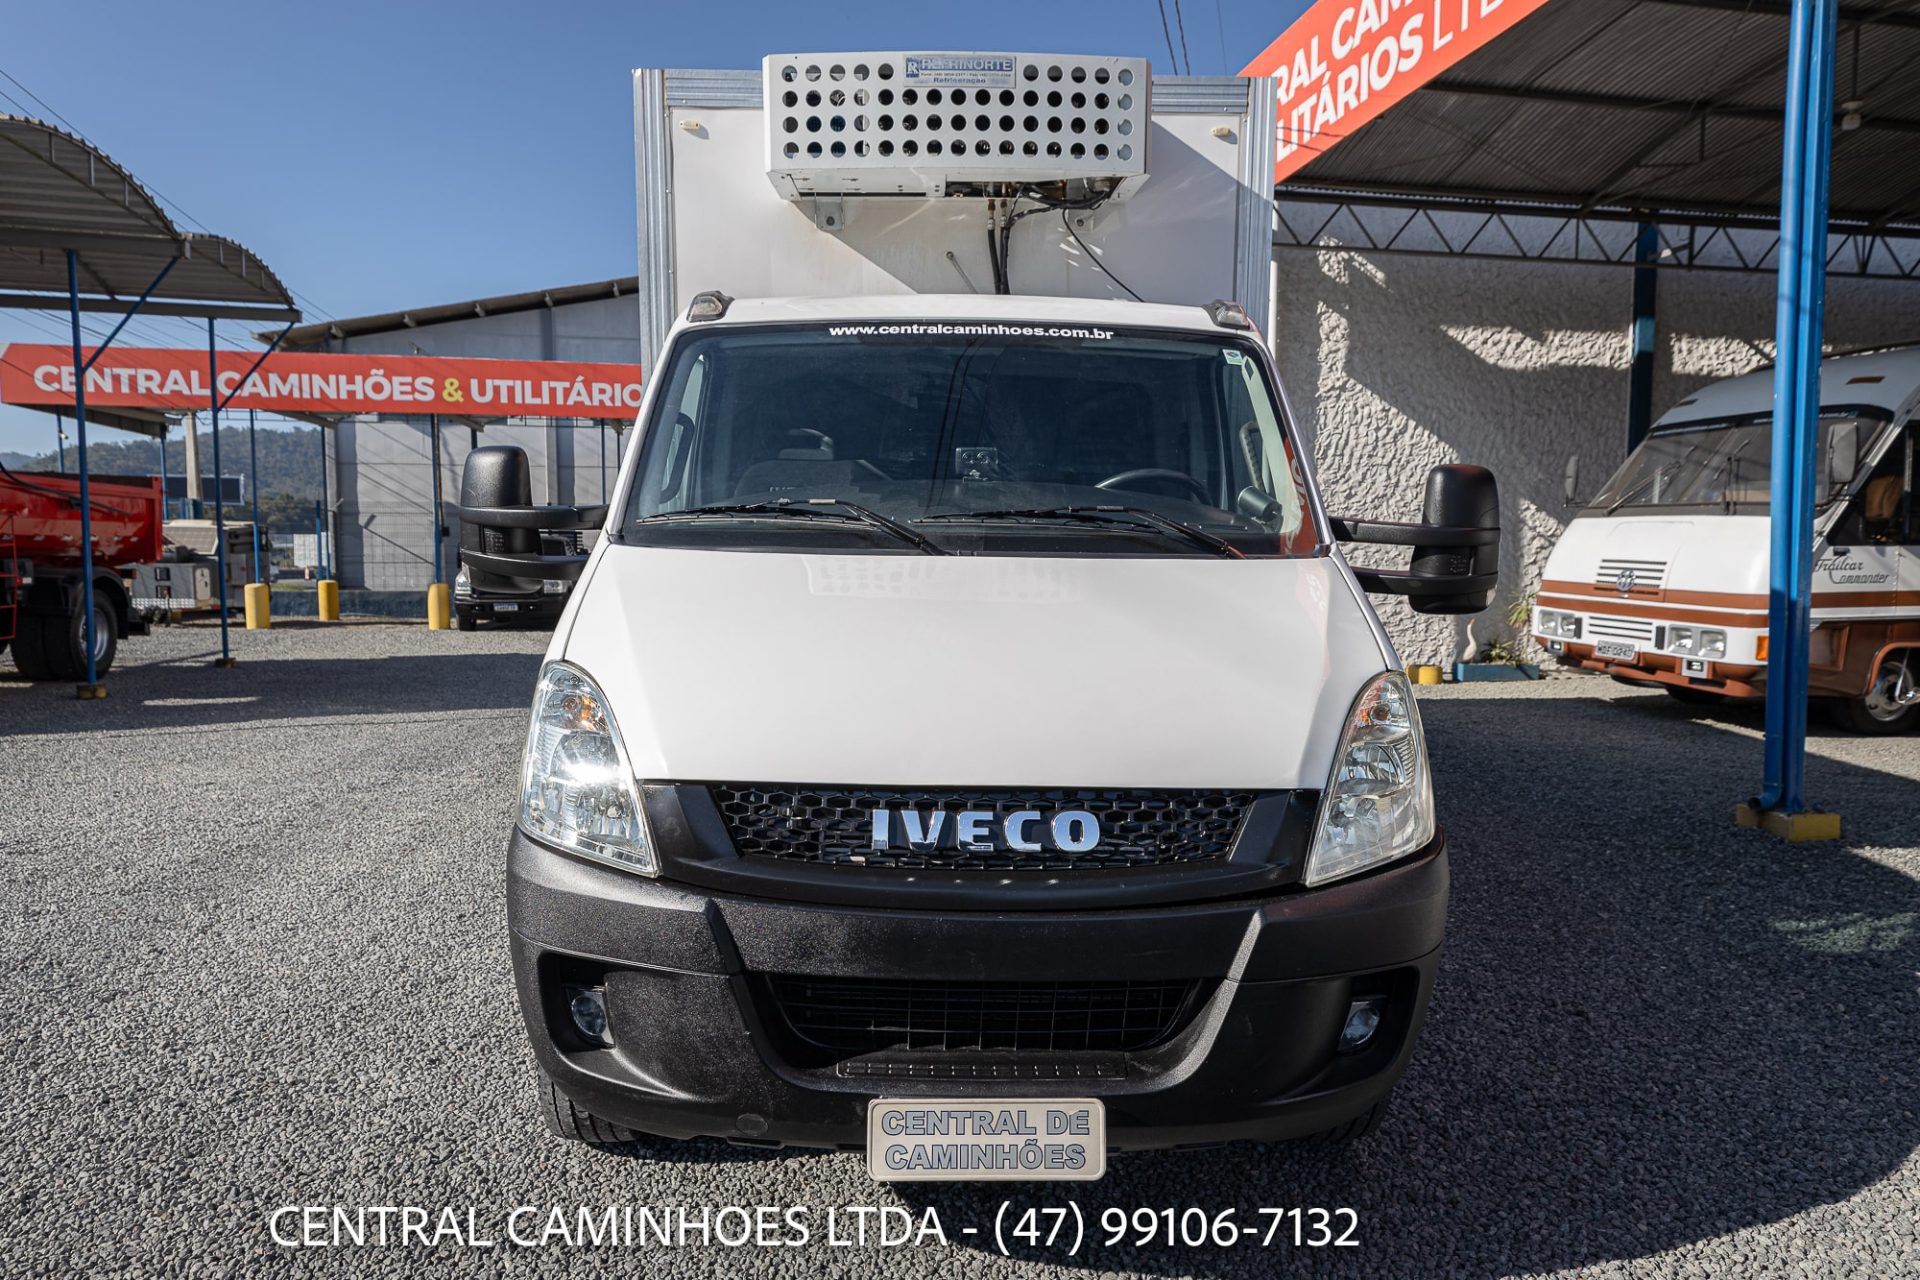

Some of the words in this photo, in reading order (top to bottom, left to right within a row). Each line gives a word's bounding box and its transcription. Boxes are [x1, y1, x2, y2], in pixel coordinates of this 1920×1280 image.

[829, 324, 1114, 340] www.centralcaminhoes.com.br
[33, 364, 211, 396] CENTRAL
[216, 368, 435, 401] CAMINHÕES
[442, 377, 464, 403] &
[871, 808, 1100, 851] IVECO
[881, 1110, 1037, 1136] CENTRAL
[1046, 1110, 1090, 1136] DE
[885, 1139, 1087, 1170] CAMINHÕES
